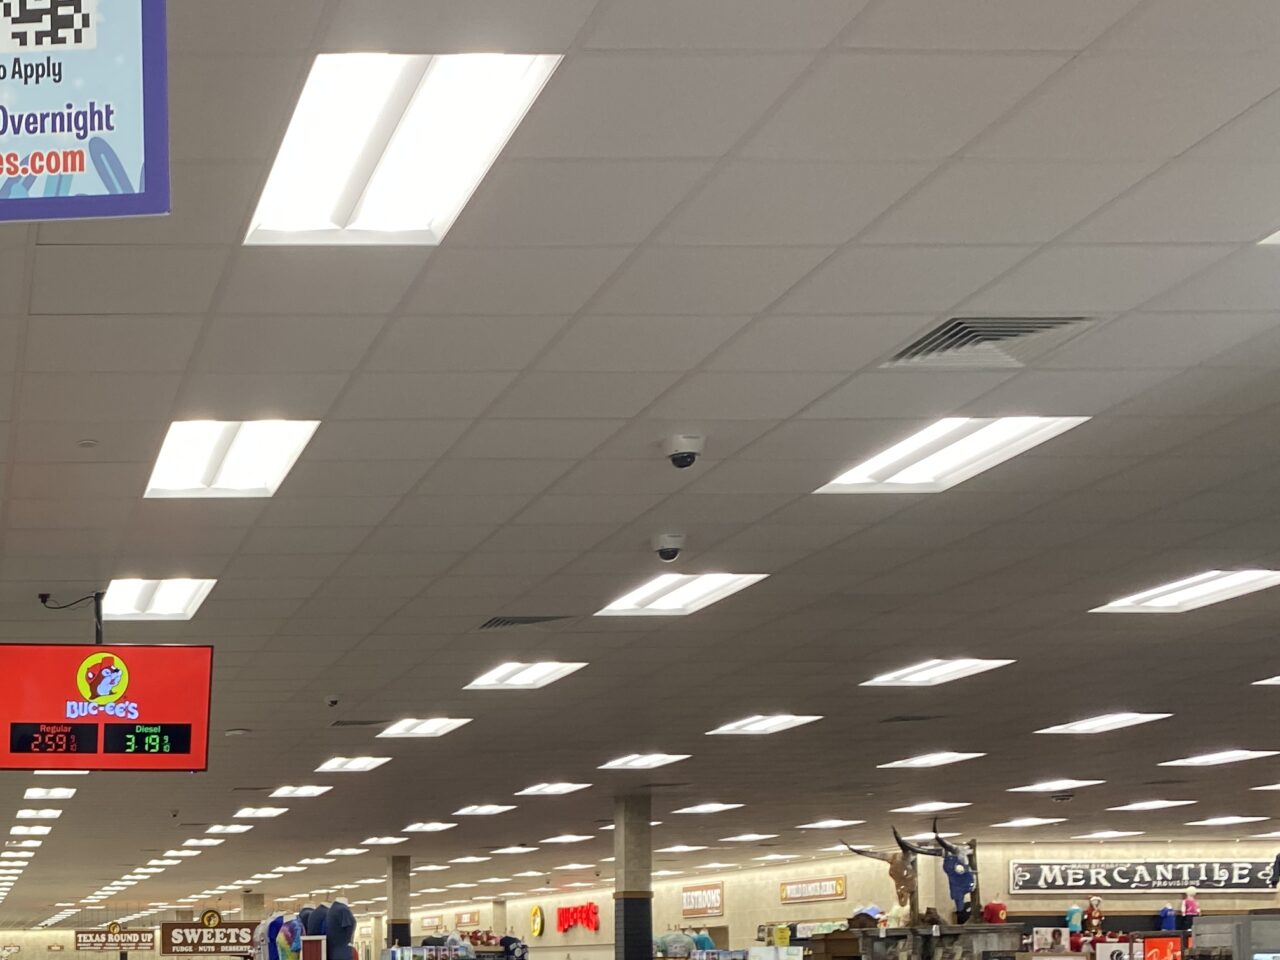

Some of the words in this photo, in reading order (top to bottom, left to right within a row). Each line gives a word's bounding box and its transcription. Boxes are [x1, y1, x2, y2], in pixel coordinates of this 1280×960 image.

[11, 56, 63, 85] Apply
[40, 724, 72, 735] Regular
[135, 724, 161, 734] Diesel
[1039, 862, 1252, 888] MERCANTILE
[77, 934, 106, 943] TEXAS
[107, 934, 139, 943] ROUND
[141, 934, 153, 943] UP
[171, 928, 251, 944] SWEETS
